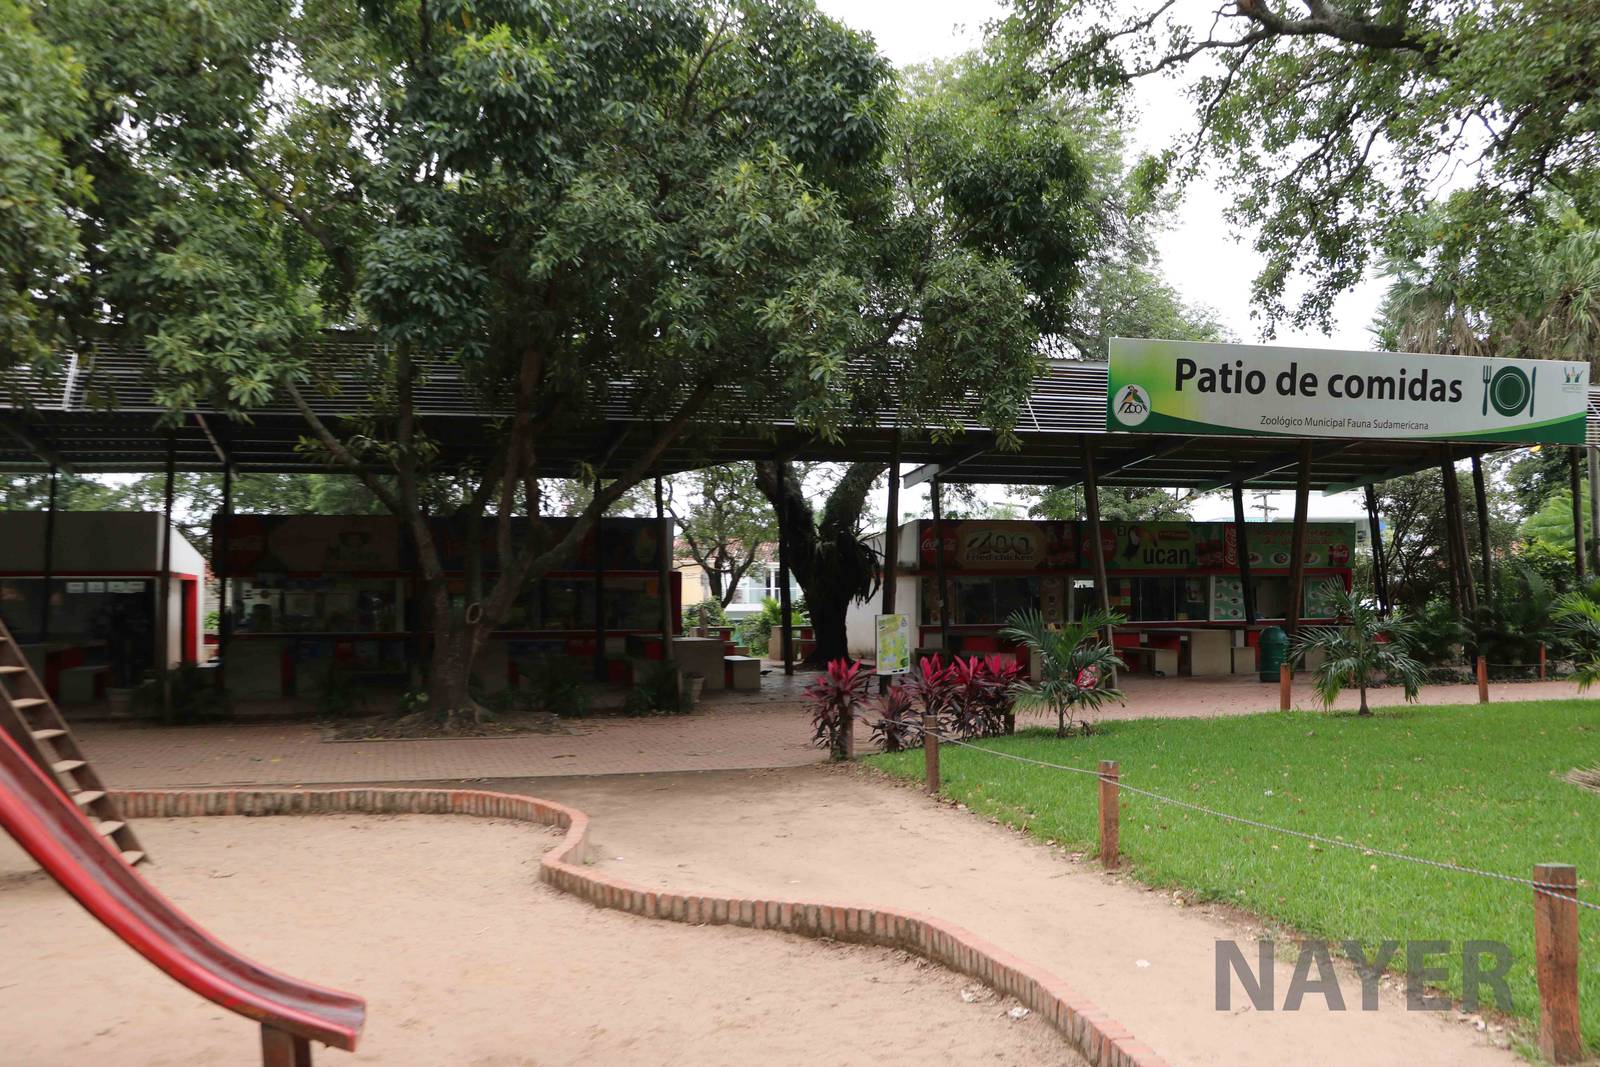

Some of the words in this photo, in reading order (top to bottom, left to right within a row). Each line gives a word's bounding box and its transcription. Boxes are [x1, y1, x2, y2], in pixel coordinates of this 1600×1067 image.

[1175, 358, 1266, 395] Patio
[1276, 362, 1318, 397] de
[1327, 368, 1463, 403] comidas
[1260, 415, 1303, 428] Zoológico
[1304, 417, 1346, 428] Municipal
[1347, 418, 1371, 429] Fauna
[1373, 419, 1429, 430] Sudamericana
